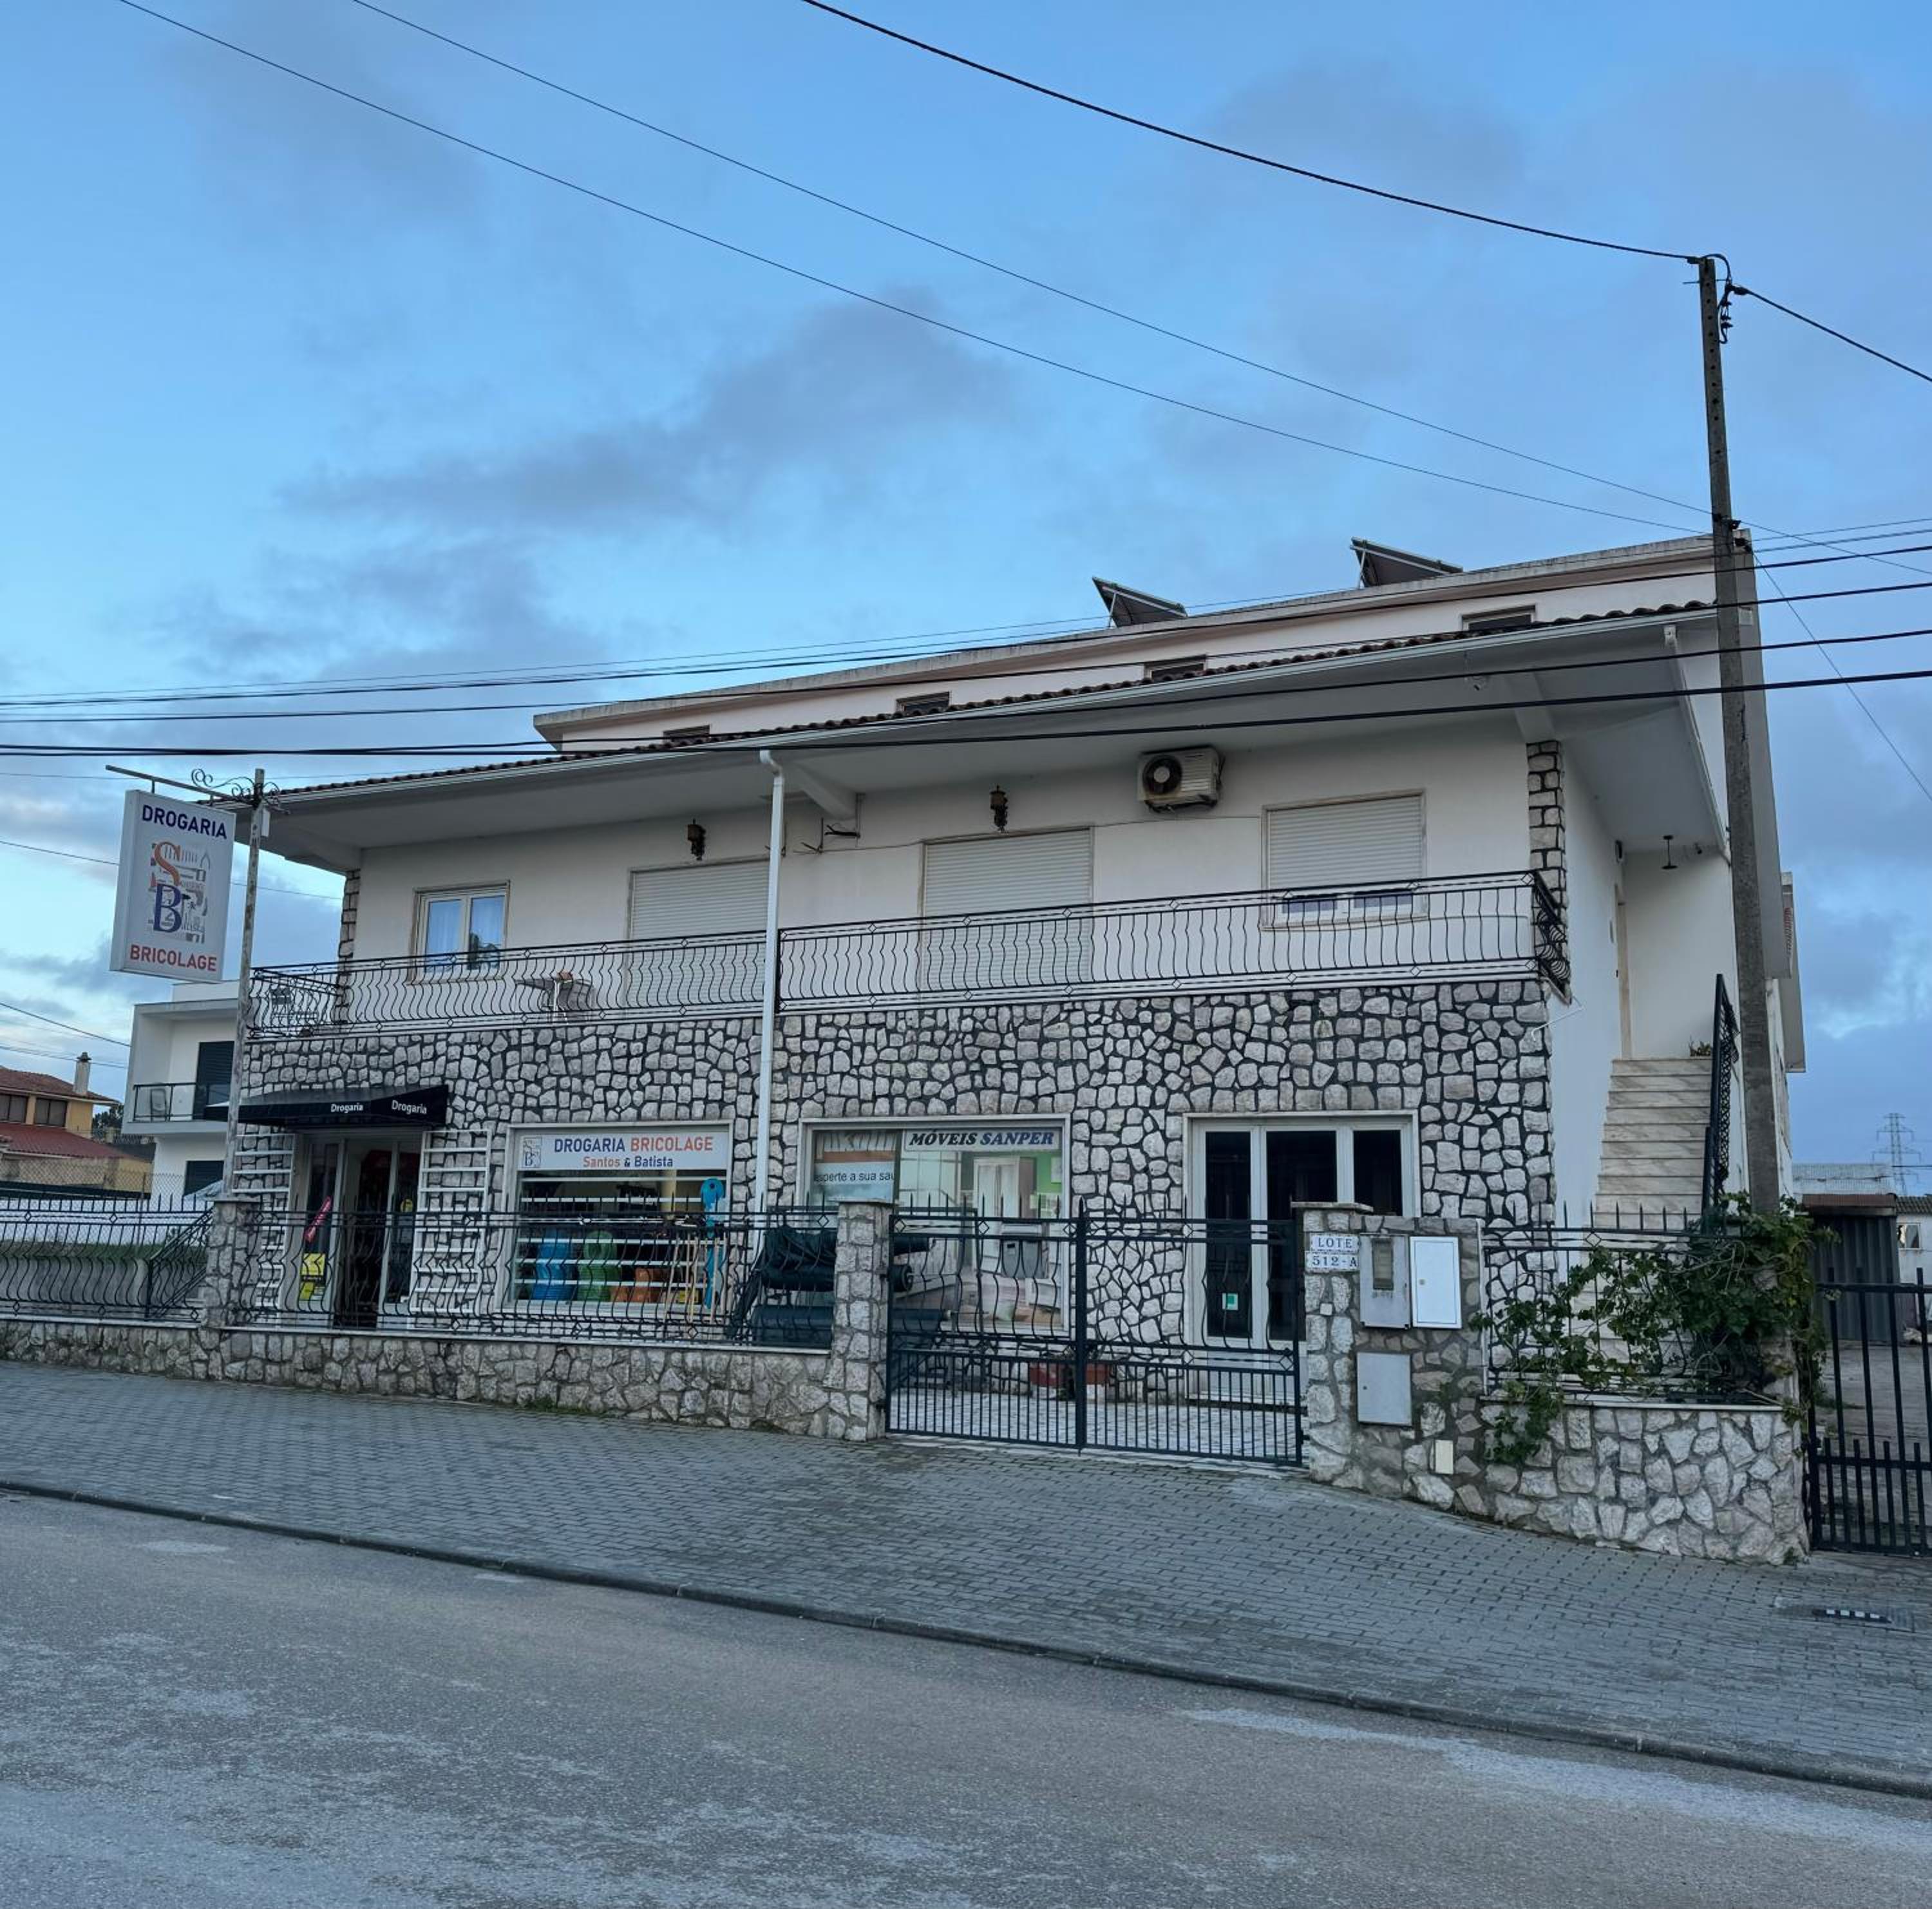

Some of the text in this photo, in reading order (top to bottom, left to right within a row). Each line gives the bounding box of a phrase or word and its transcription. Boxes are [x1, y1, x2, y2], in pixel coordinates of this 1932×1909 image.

[142, 804, 227, 839] DROGARIA
[129, 944, 217, 972] BRICOLAGE
[330, 1102, 364, 1114] Drogaria
[391, 1099, 428, 1115] Drogaria
[909, 1129, 1055, 1145] MÓVEIS SANPER
[554, 1136, 714, 1153] DROGARIA BRICOLAGE
[583, 1155, 673, 1168] Santos & Batista
[858, 1172, 876, 1181] sua
[1318, 1237, 1352, 1248] LOTE
[1312, 1256, 1358, 1267] 512-A
